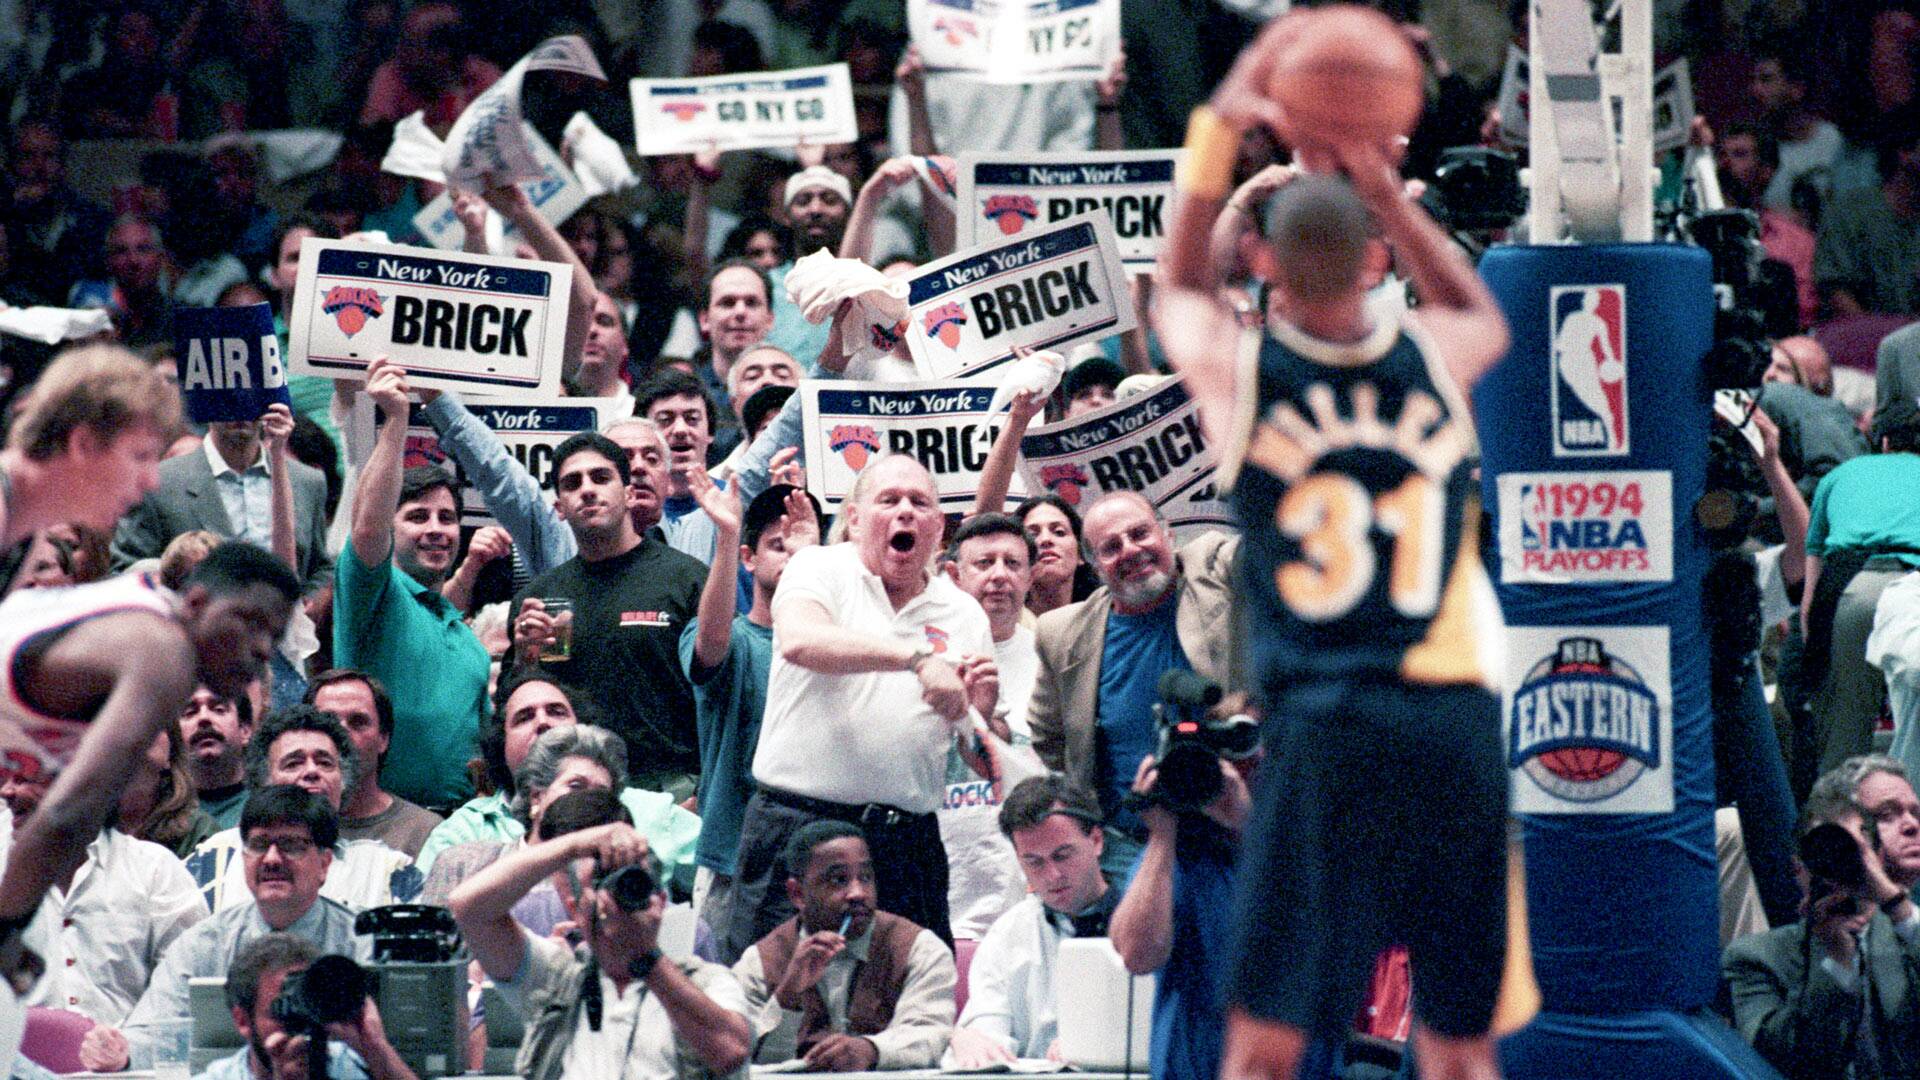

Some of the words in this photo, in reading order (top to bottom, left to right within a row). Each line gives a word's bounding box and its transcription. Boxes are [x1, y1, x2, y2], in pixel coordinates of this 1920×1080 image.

[1028, 166, 1077, 184] New
[1080, 165, 1128, 183] York
[376, 258, 433, 281] New
[437, 264, 491, 289] York
[943, 260, 989, 289] New
[990, 241, 1042, 271] York
[969, 260, 1100, 340] BRICK
[390, 294, 533, 357] BRICK
[184, 338, 252, 390] AIR
[260, 334, 288, 389] B
[490, 409, 542, 429] York
[868, 395, 915, 414] New
[919, 390, 972, 413] York
[1058, 425, 1109, 452] New
[1109, 400, 1162, 435] York
[888, 423, 1002, 475] BRIC
[1550, 481, 1644, 517] 1994
[1273, 472, 1446, 621] 31
[1550, 519, 1647, 549] NBA
[1522, 549, 1649, 573] PLAYOFFS
[1517, 680, 1652, 752] EASTERN
